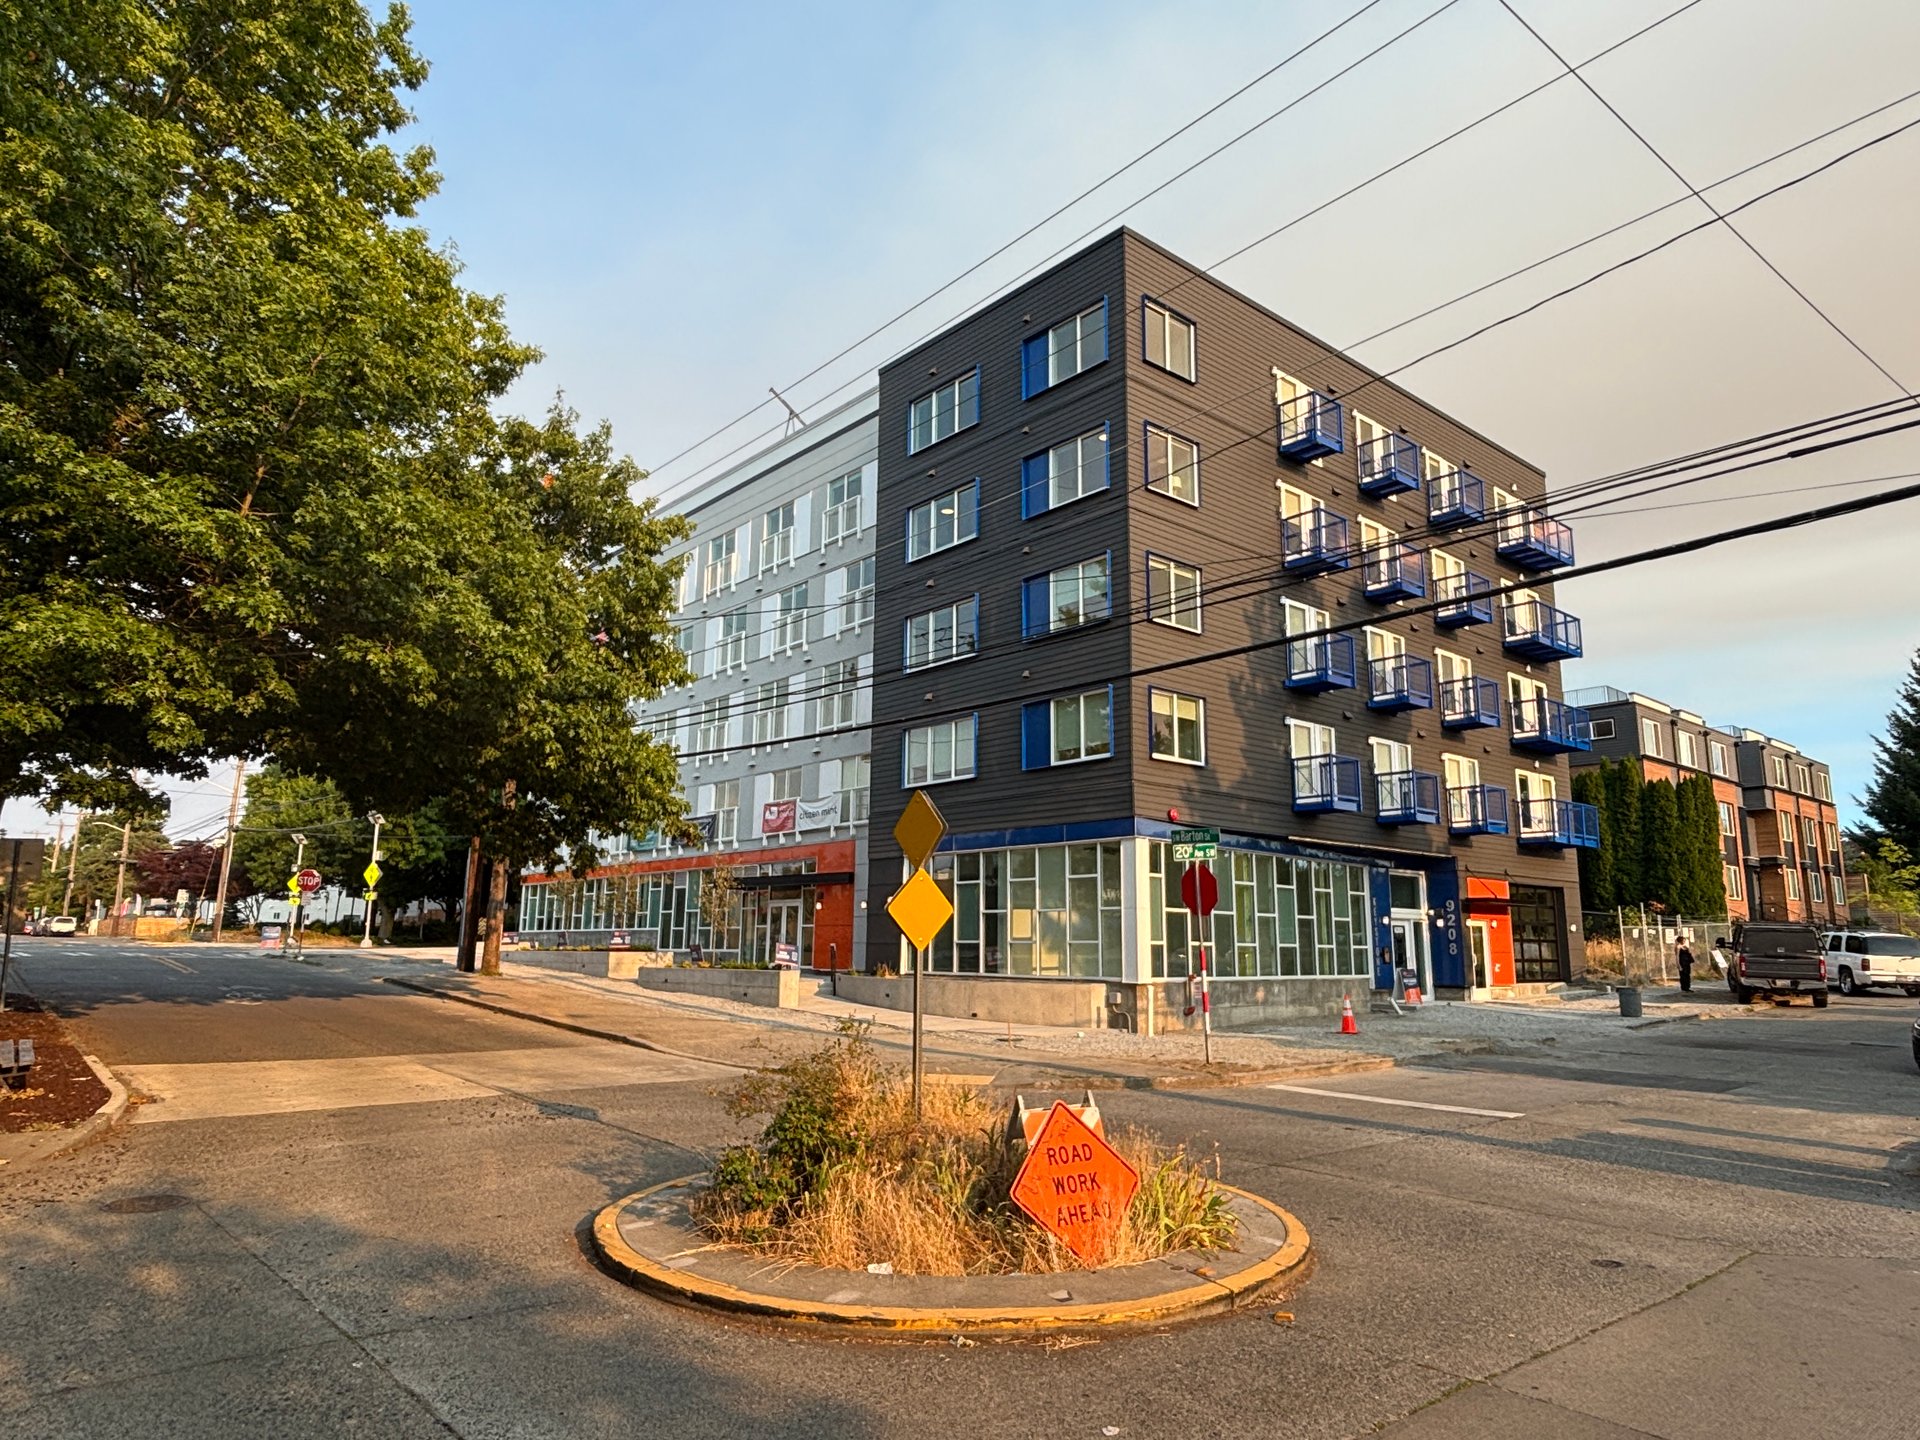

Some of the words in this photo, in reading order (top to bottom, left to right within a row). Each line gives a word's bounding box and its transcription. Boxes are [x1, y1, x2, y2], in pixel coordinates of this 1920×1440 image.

[799, 810, 820, 820] citizen
[821, 805, 838, 816] mint
[1180, 830, 1204, 841] Barton
[1205, 848, 1215, 857] SW
[298, 876, 320, 886] STOP
[1445, 899, 1458, 955] 9208
[1046, 1143, 1093, 1166] ROAD
[1052, 1171, 1101, 1196] WORK
[1057, 1201, 1112, 1228] AHEAD
